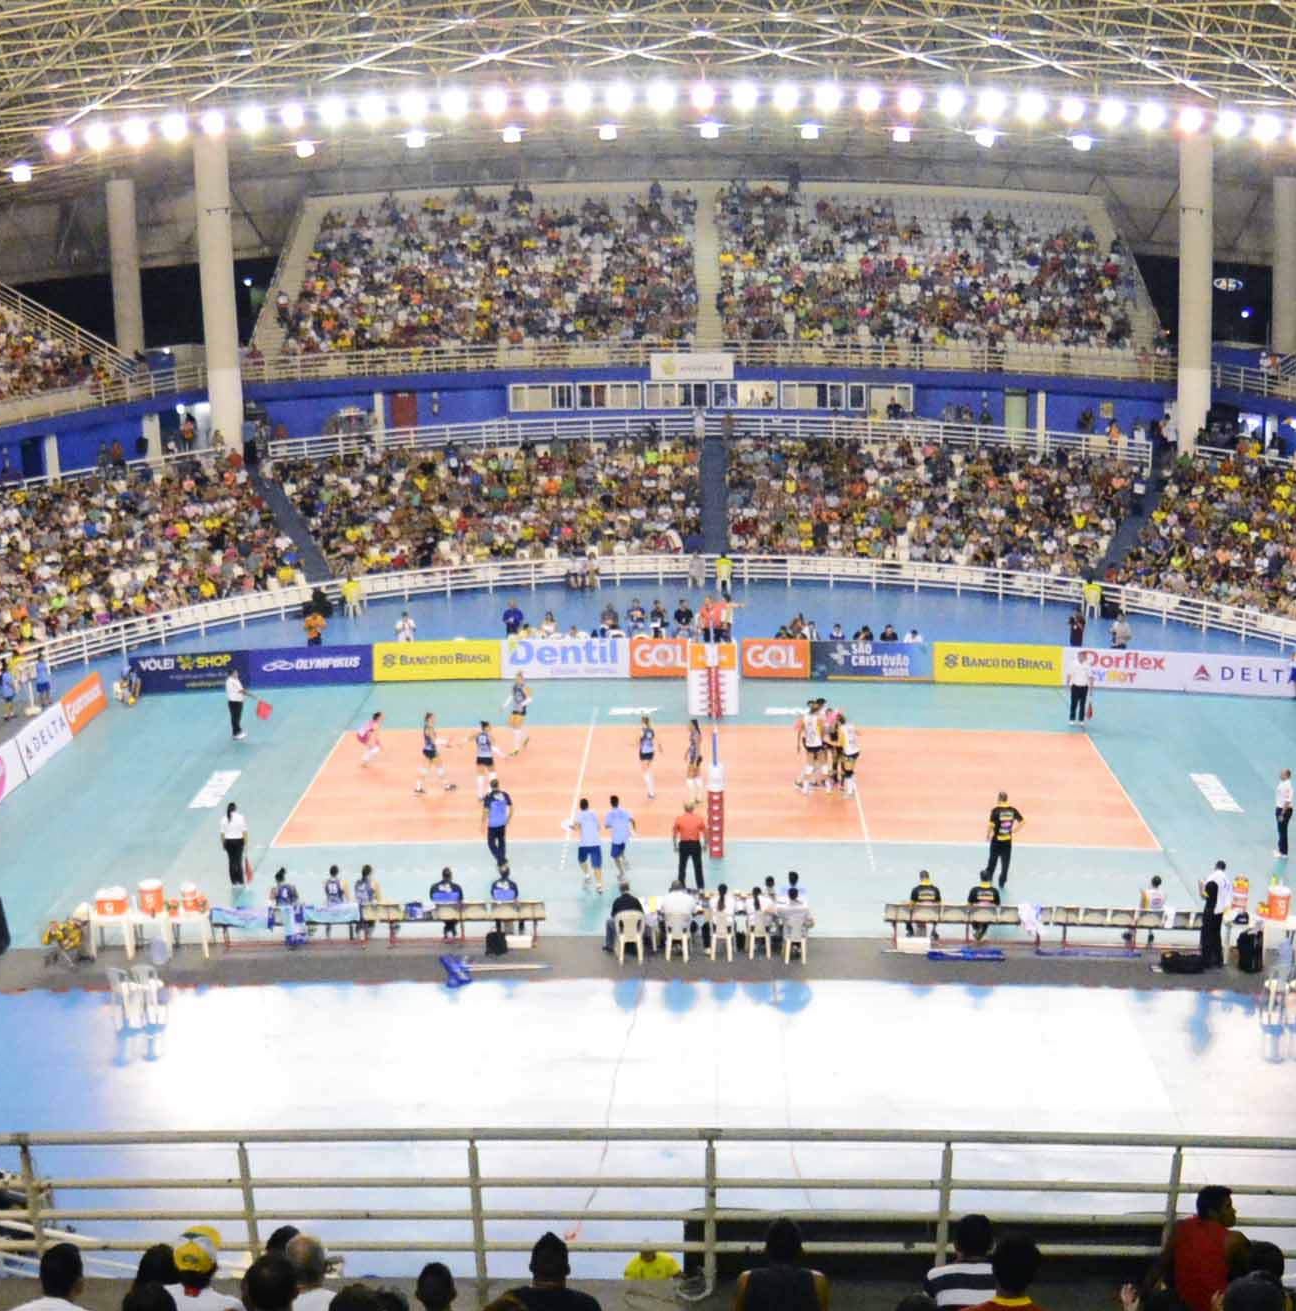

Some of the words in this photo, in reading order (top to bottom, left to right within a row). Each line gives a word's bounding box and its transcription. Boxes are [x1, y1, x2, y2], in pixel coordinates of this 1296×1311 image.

[509, 639, 619, 666] Dentil
[634, 644, 687, 667] GOL
[850, 641, 872, 655] SÃO
[195, 654, 233, 669] SHOP
[295, 656, 361, 671] OLYMPIKUS
[399, 654, 439, 666] BANCO
[454, 652, 492, 665] BRASIL
[746, 644, 803, 669] GOL
[850, 653, 910, 667] CRISTÓVÃO
[961, 655, 1000, 669] BANCO
[1017, 657, 1054, 671] BRASIL
